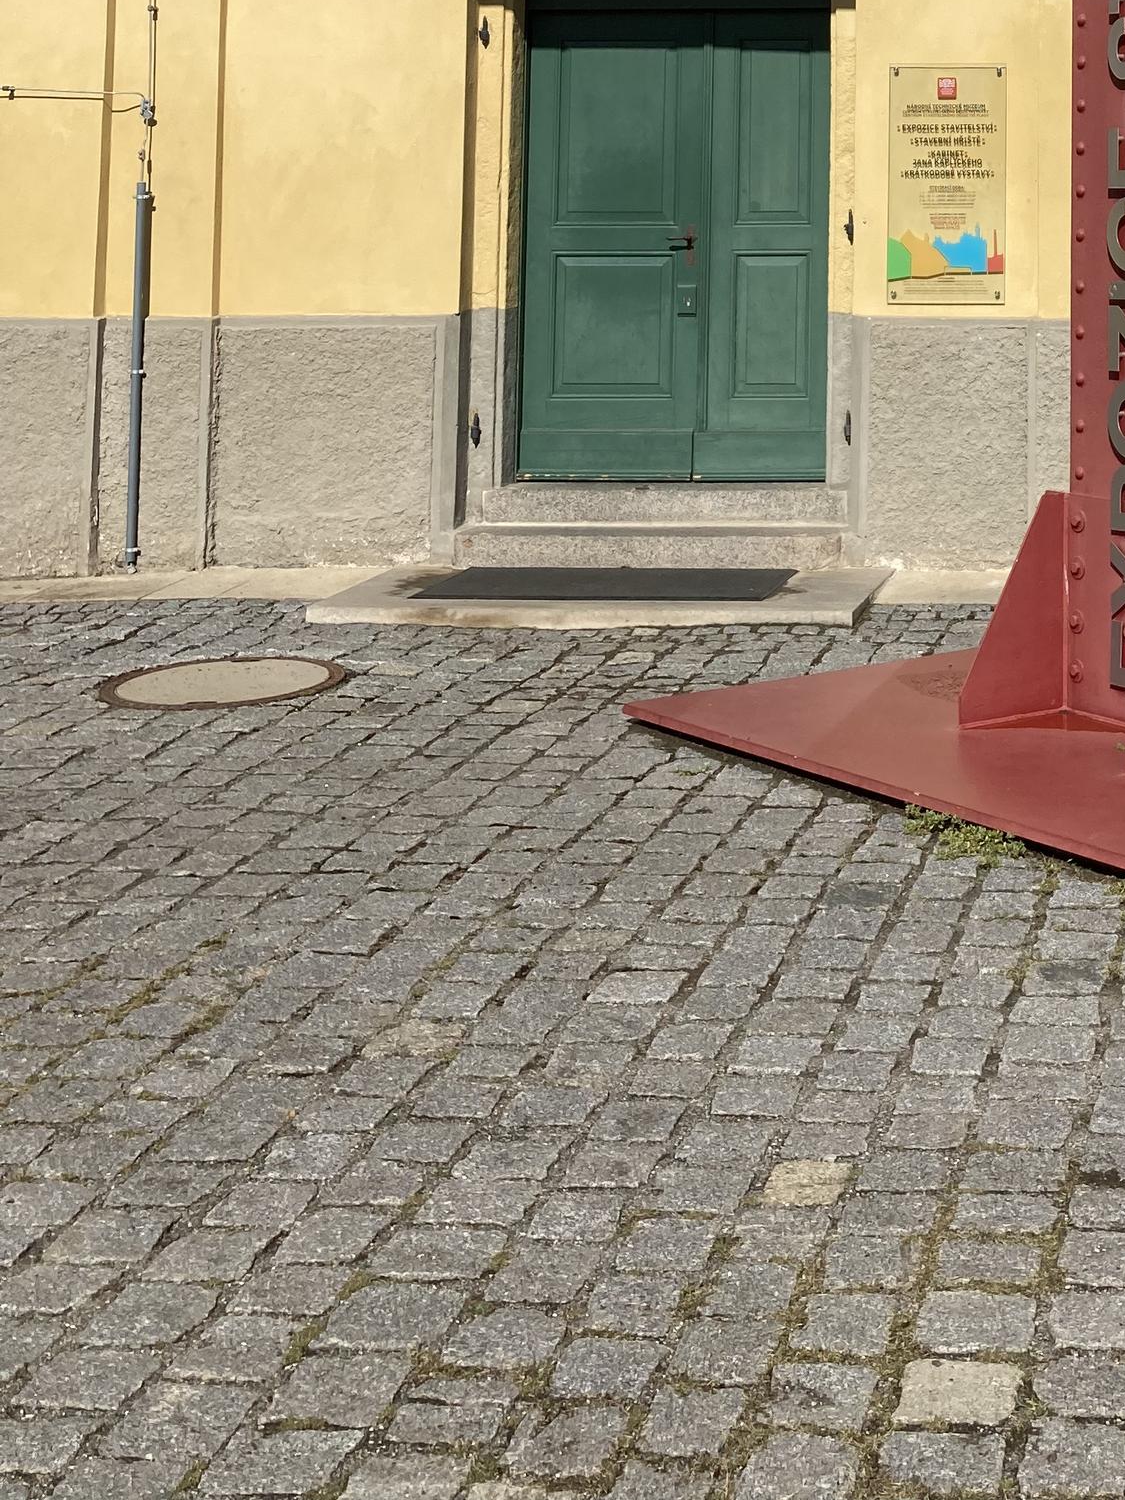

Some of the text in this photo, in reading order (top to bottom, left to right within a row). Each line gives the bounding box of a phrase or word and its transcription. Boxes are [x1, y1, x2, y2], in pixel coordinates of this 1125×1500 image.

[902, 123, 993, 132] EXPOZICE STAVITELSTVÍ
[914, 136, 951, 145] STAVEBNÍ
[931, 150, 964, 158] KABINET
[913, 159, 932, 167] JANA
